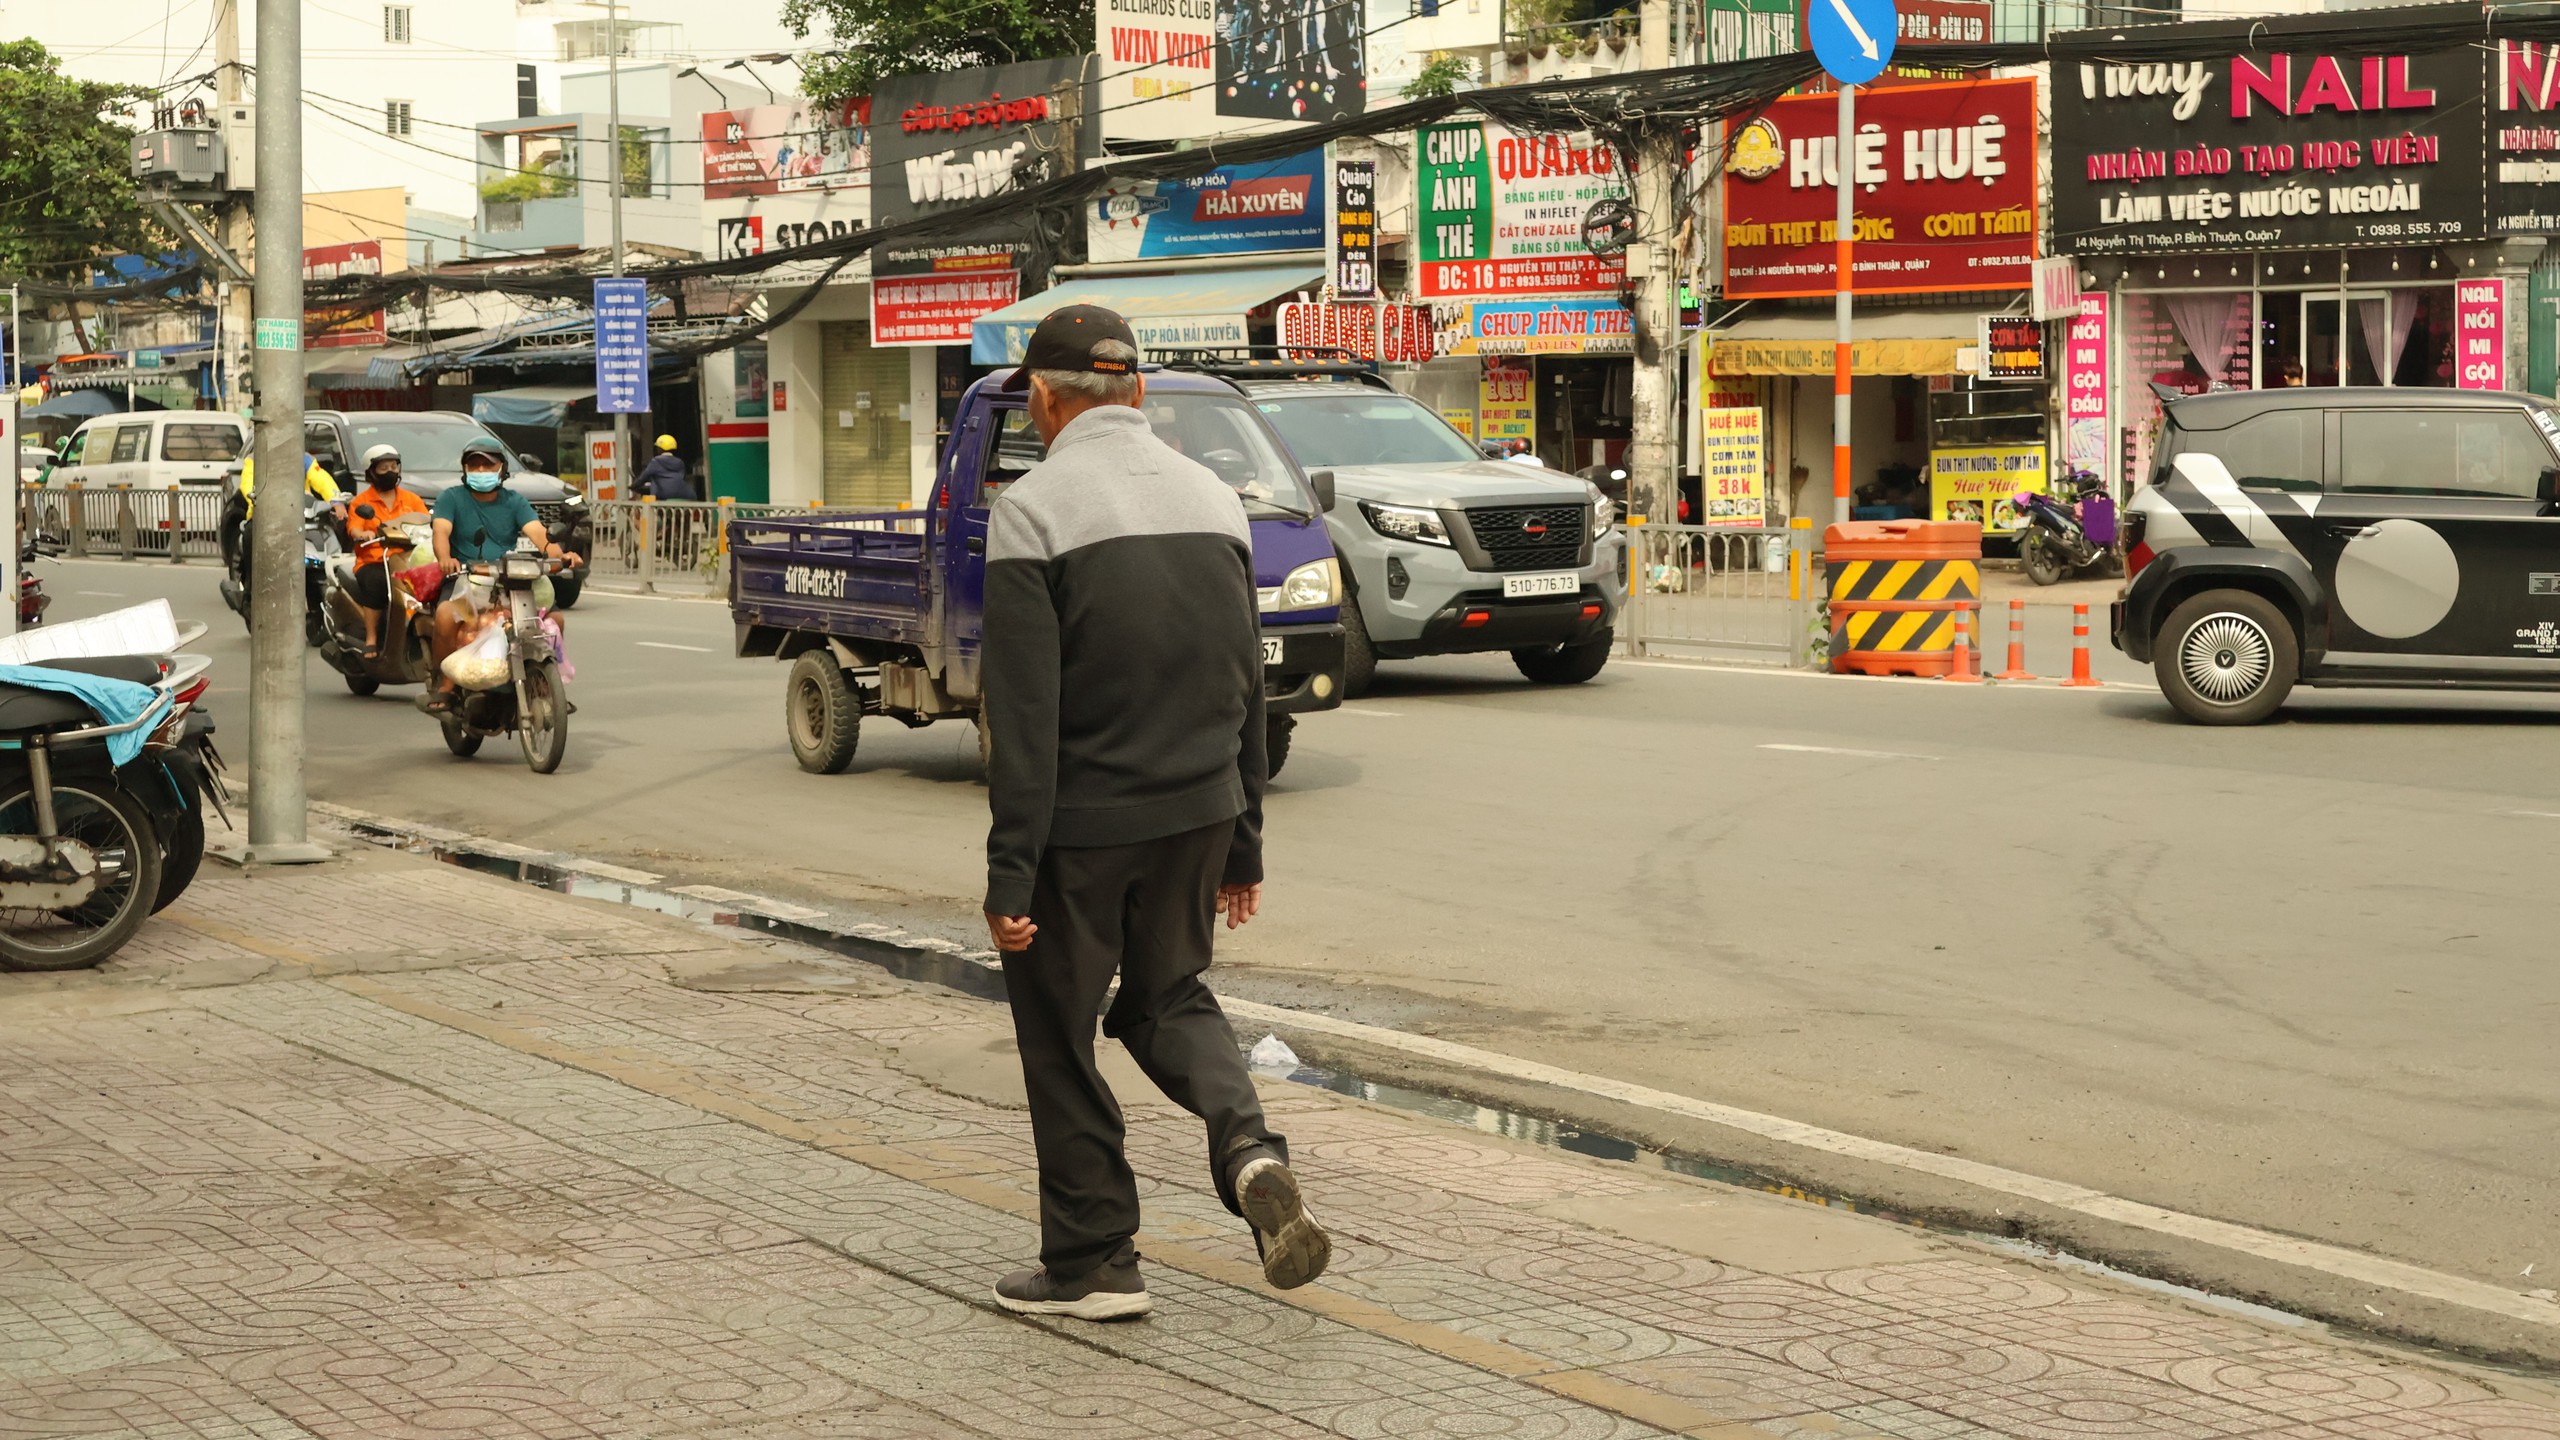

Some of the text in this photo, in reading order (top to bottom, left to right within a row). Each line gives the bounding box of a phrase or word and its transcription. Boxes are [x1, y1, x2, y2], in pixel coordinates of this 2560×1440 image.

[1111, 0, 1211, 19] BILLIARDS CLUB
[1964, 17, 1983, 41] LED
[1112, 27, 1211, 69] WIN WIN
[1133, 77, 1163, 98] BIDA
[2230, 52, 2436, 118] NAIL
[1426, 128, 1482, 173] CHỤP
[1903, 114, 2006, 187] HUỆ
[2087, 131, 2438, 184] NHẬN ĐÀO TẠO HỌC VIÊN
[1339, 165, 1372, 190] Quảng
[1431, 169, 1477, 212] ẢNH
[1505, 187, 1599, 204] BẢNG HIỆU HỘP
[1206, 188, 1304, 216] HẢI XUYÊN
[1525, 207, 1577, 219] IN HIFLET
[2100, 178, 2420, 226] LÀM VIỆC NƯỚC NGOÀI
[1435, 214, 1475, 259] THẺ
[1549, 223, 1576, 236] ZALE
[1727, 203, 2032, 248] BÚN THỊT NỚNG CƠM TẤM
[2076, 236, 2087, 248] 14
[2089, 234, 2126, 250] Nguyễn
[2129, 233, 2144, 248] Thị
[2185, 230, 2207, 243] Bình
[2209, 231, 2243, 244] Thuận,
[2245, 229, 2273, 243] Quận
[2274, 229, 2281, 239] 7
[1340, 262, 1371, 292] LED
[1438, 264, 1494, 290] ĐC: 16
[1500, 259, 1597, 275] NGUYỄN THỊ THẬP, P.
[1729, 266, 1742, 278] ĐỊA
[1758, 265, 1766, 275] 14
[1767, 262, 1794, 275] NGUYỄN
[1795, 264, 1806, 276] THỊ
[1859, 260, 1876, 272] BÌNH
[1877, 259, 1901, 272] THUẬN
[1905, 259, 1924, 271] QUẬN
[1924, 259, 1931, 269] 7
[1500, 273, 1580, 288] ĐT: 0939.559012
[2044, 264, 2079, 312] NAIL
[2461, 287, 2499, 303] NAIL
[2081, 300, 2103, 316] AIL
[2464, 307, 2496, 329] NỐI
[1279, 284, 1434, 362] QUẢNG CÁO
[1537, 305, 1592, 336] HÌNH
[2072, 319, 2101, 340] NỐI
[1137, 322, 1242, 345] TẠP HÓA HẢI XUYÊN
[2017, 323, 2039, 346] TẤM
[2076, 349, 2097, 364] MI
[2469, 338, 2491, 355] MI
[2073, 370, 2101, 391] GỘI
[2465, 361, 2496, 384] GỘI
[2071, 392, 2103, 413] ĐẦU
[1936, 449, 2040, 475] BÚN THỊT NƯỚNG CƠM TẤM
[1954, 477, 2020, 496] Huệ Huệ
[2516, 629, 2551, 638] GRAND
[2538, 621, 2555, 630] XIV
[2534, 637, 2558, 645] 1995
